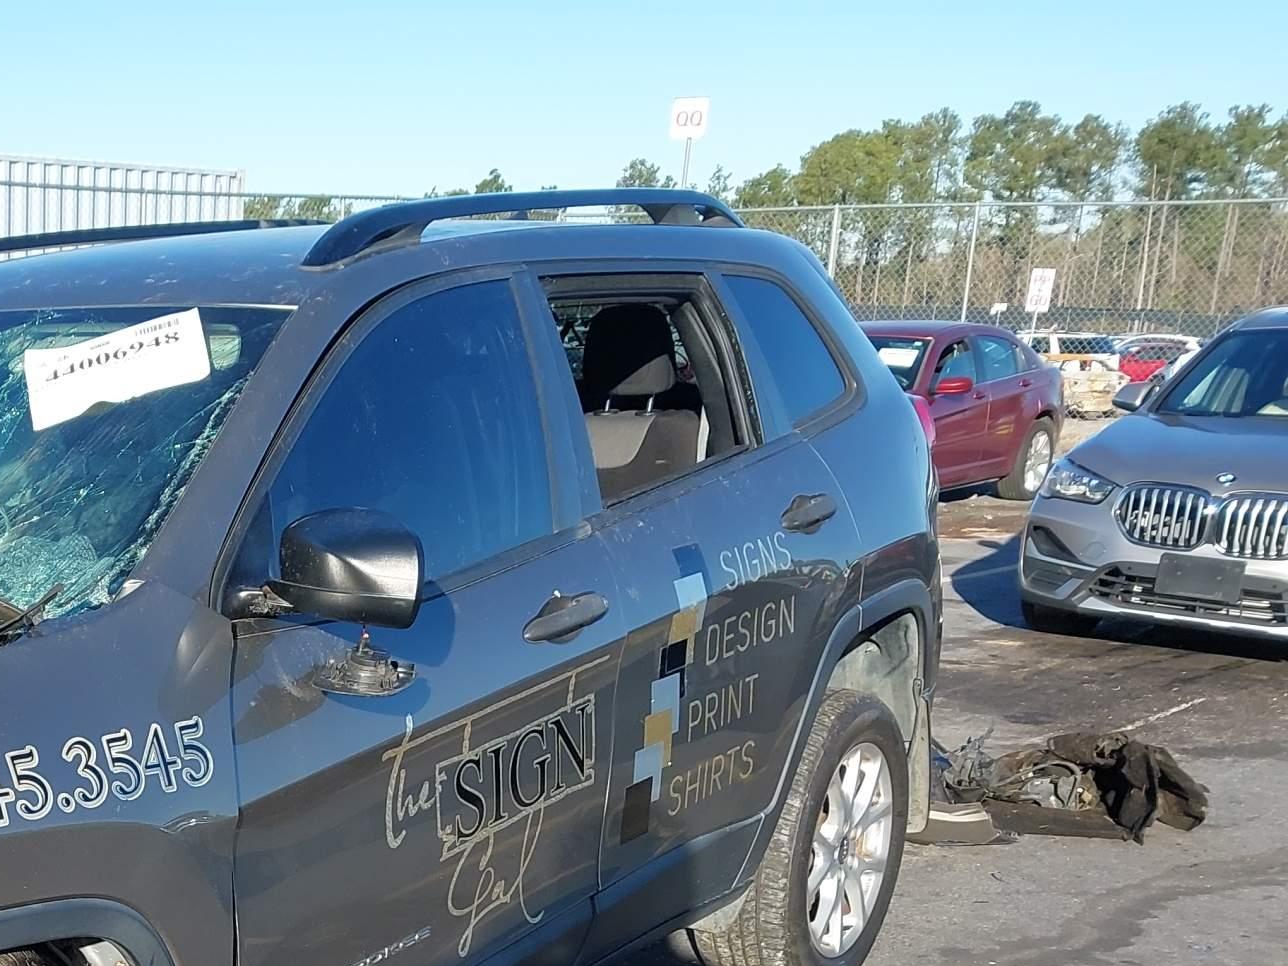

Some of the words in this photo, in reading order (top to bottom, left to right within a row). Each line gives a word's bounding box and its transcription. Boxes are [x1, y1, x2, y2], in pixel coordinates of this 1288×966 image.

[44, 331, 180, 382] 44006948
[719, 531, 792, 591] SIGNS
[705, 595, 795, 666] DESIGN
[687, 673, 759, 743] PRINT
[454, 703, 592, 841] SIGN
[667, 739, 756, 816] SHIRTS
